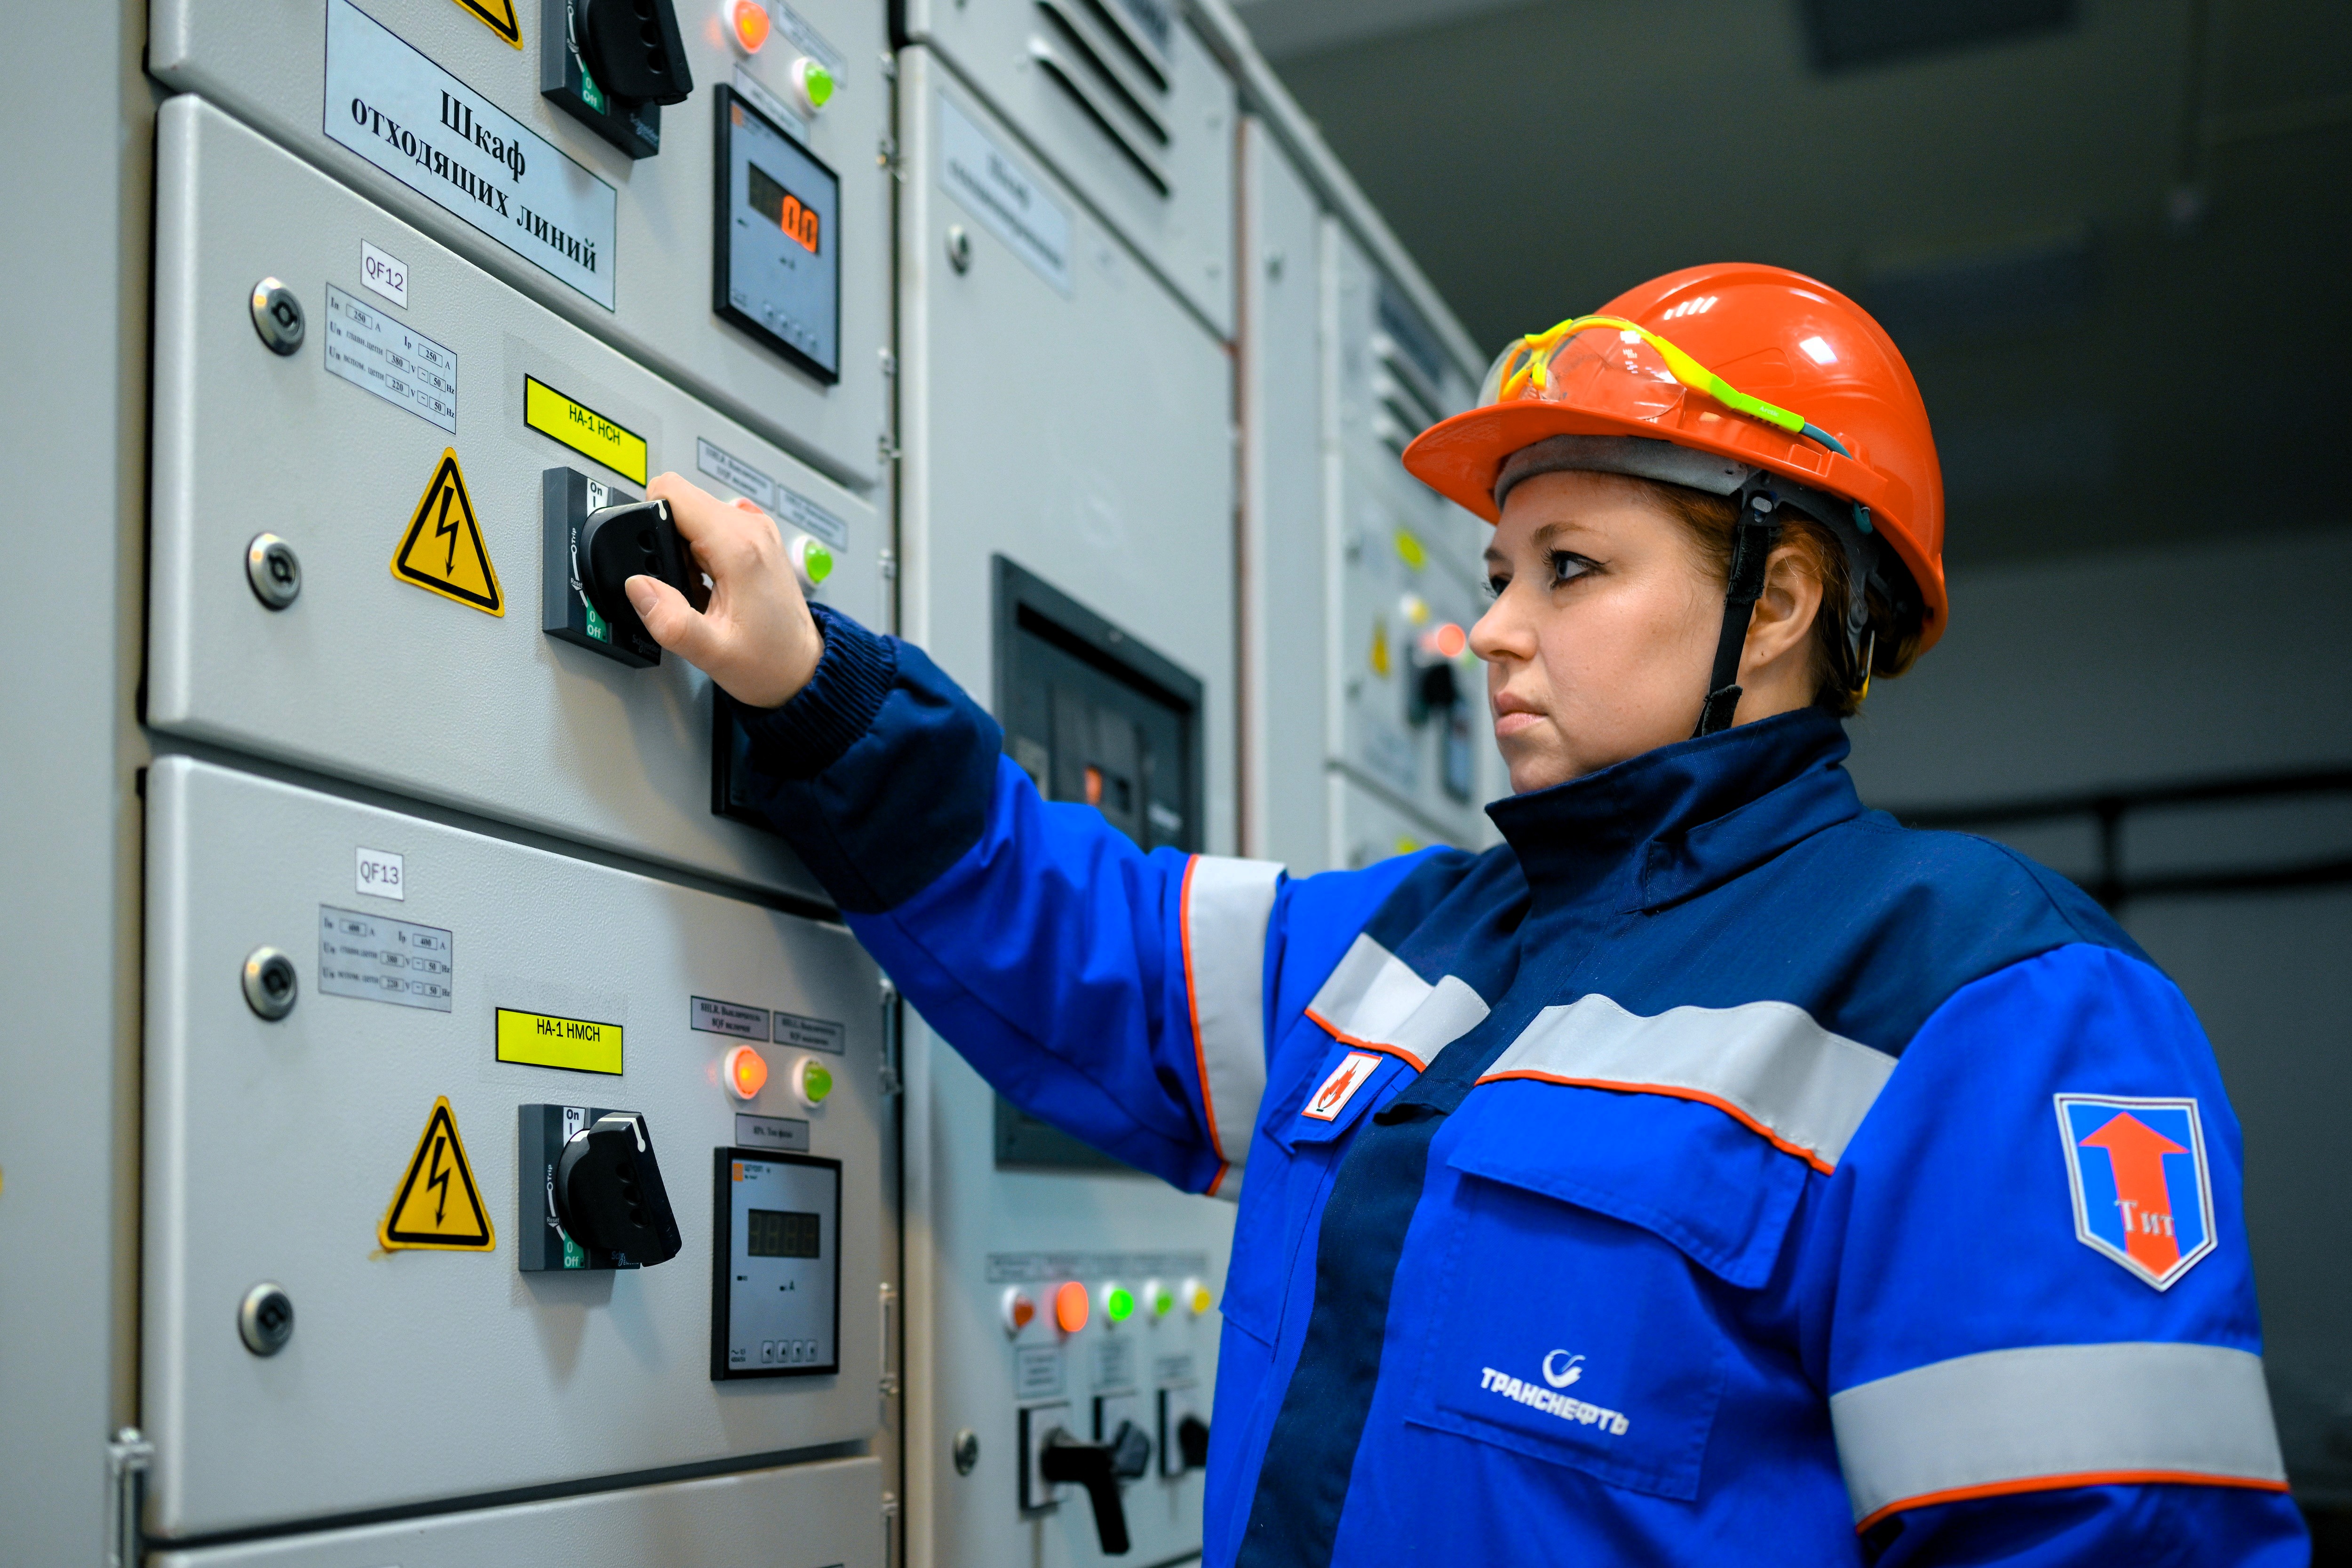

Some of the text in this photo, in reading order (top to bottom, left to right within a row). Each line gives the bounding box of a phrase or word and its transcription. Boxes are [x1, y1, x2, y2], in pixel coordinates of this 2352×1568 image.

[439, 89, 525, 183] Шкаф
[351, 98, 596, 273] отходящих линий
[366, 256, 403, 292] QF12
[354, 310, 366, 323] 250
[426, 350, 437, 362] 250
[445, 361, 450, 370] A
[391, 355, 403, 367] 380
[434, 377, 441, 387] 50
[447, 384, 454, 394] Hz
[392, 380, 403, 391] 220
[435, 401, 441, 411] 50
[447, 408, 454, 418] Hz
[570, 405, 595, 432] НА-1
[590, 482, 603, 496] On
[571, 578, 583, 588] Reset
[587, 624, 601, 638] Off
[360, 861, 399, 884] QF13
[537, 1019, 564, 1037] НА-1
[566, 1109, 579, 1120] On
[2114, 1200, 2174, 1237] Тит
[564, 1256, 579, 1267] Off
[1480, 1367, 1629, 1435] ТРАНСНЕФТЬ
